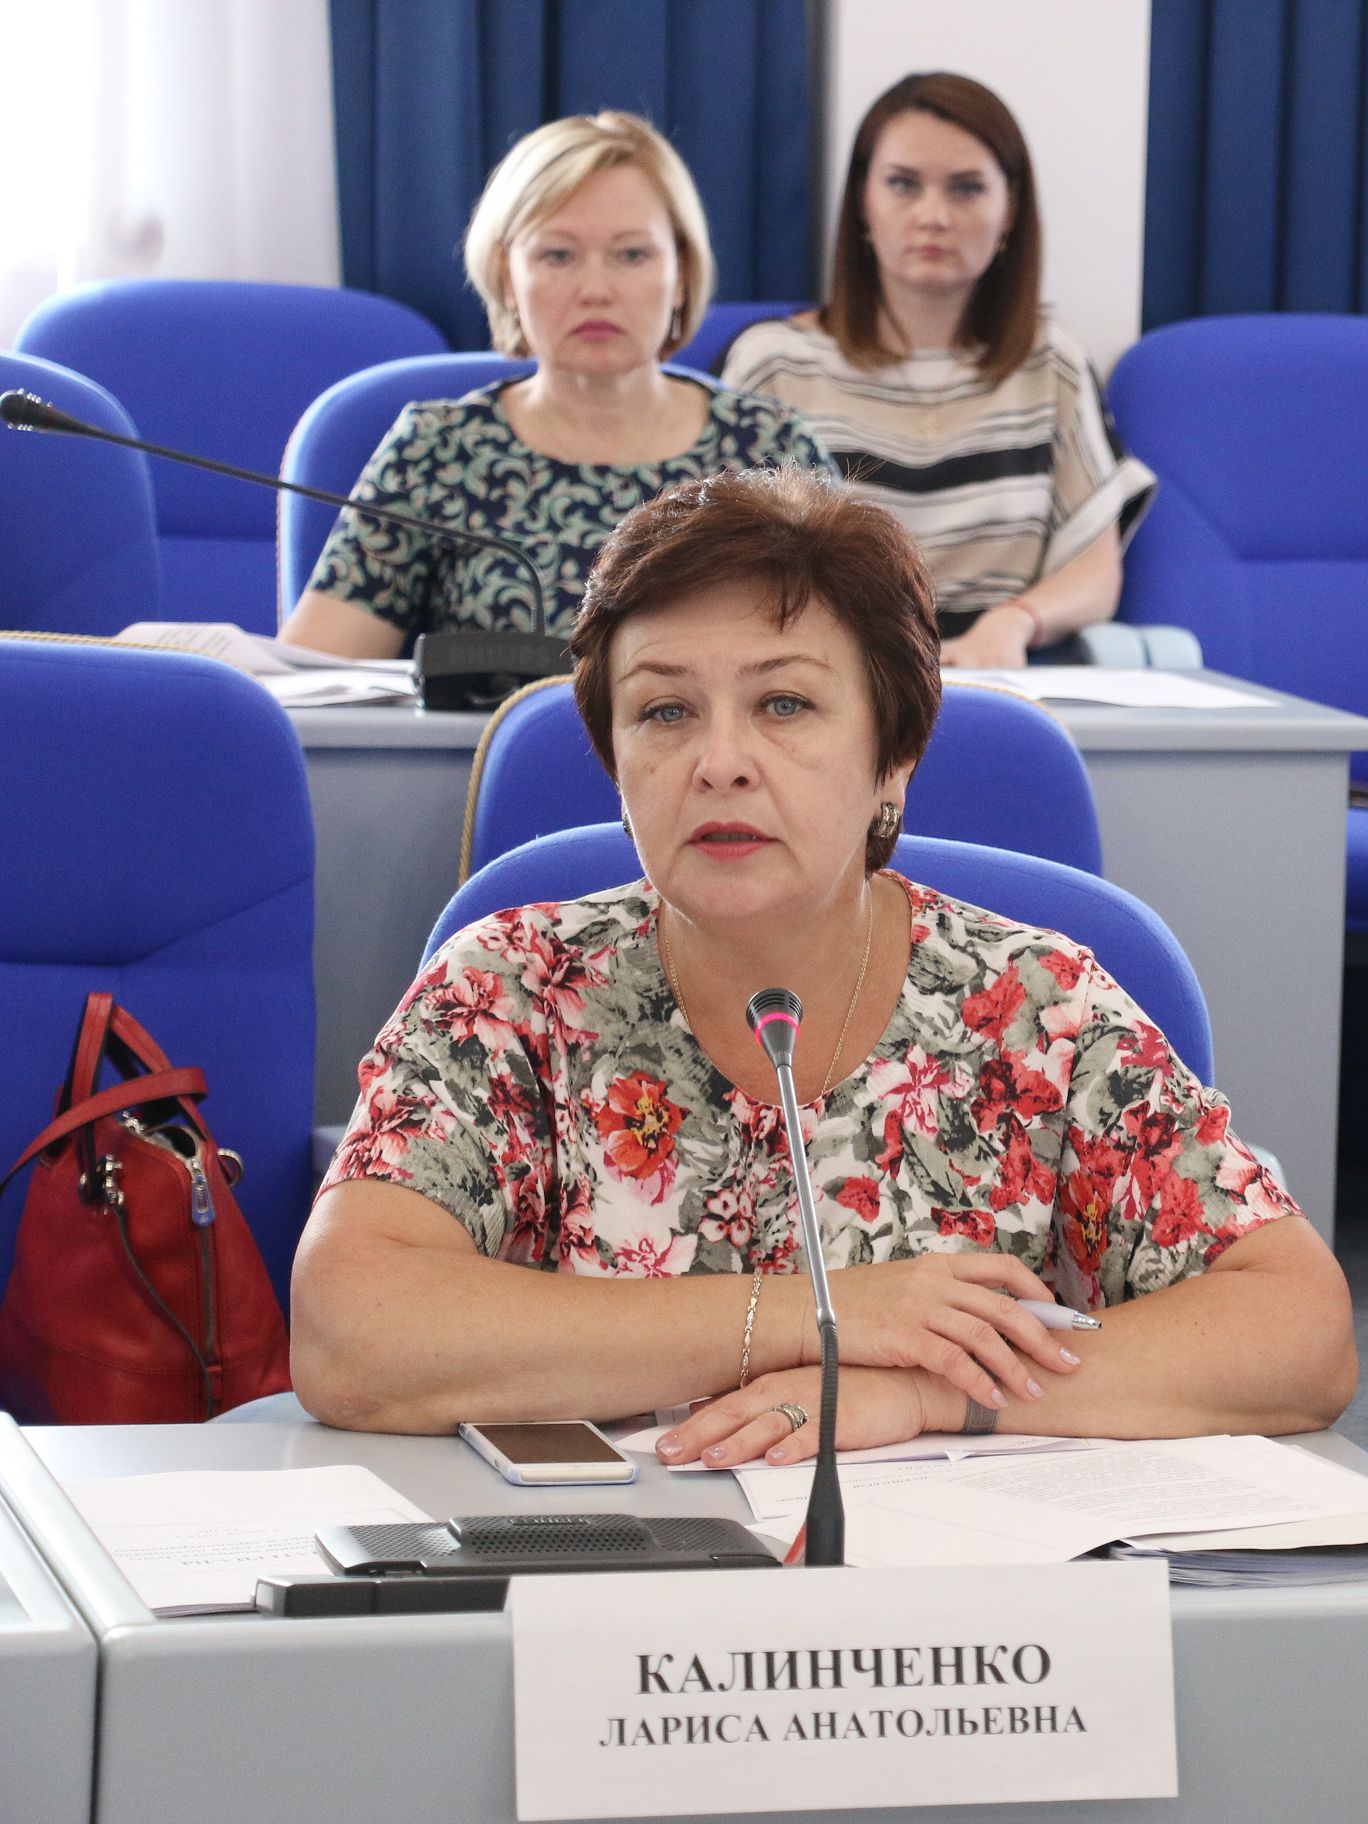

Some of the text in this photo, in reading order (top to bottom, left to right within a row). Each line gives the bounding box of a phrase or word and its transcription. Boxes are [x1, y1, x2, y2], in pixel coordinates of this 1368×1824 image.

[635, 1644, 1052, 1695] КАЛИНЧЕНКО
[600, 1704, 1088, 1748] ЛАРИСА АНАТОЛЬЕВНА
